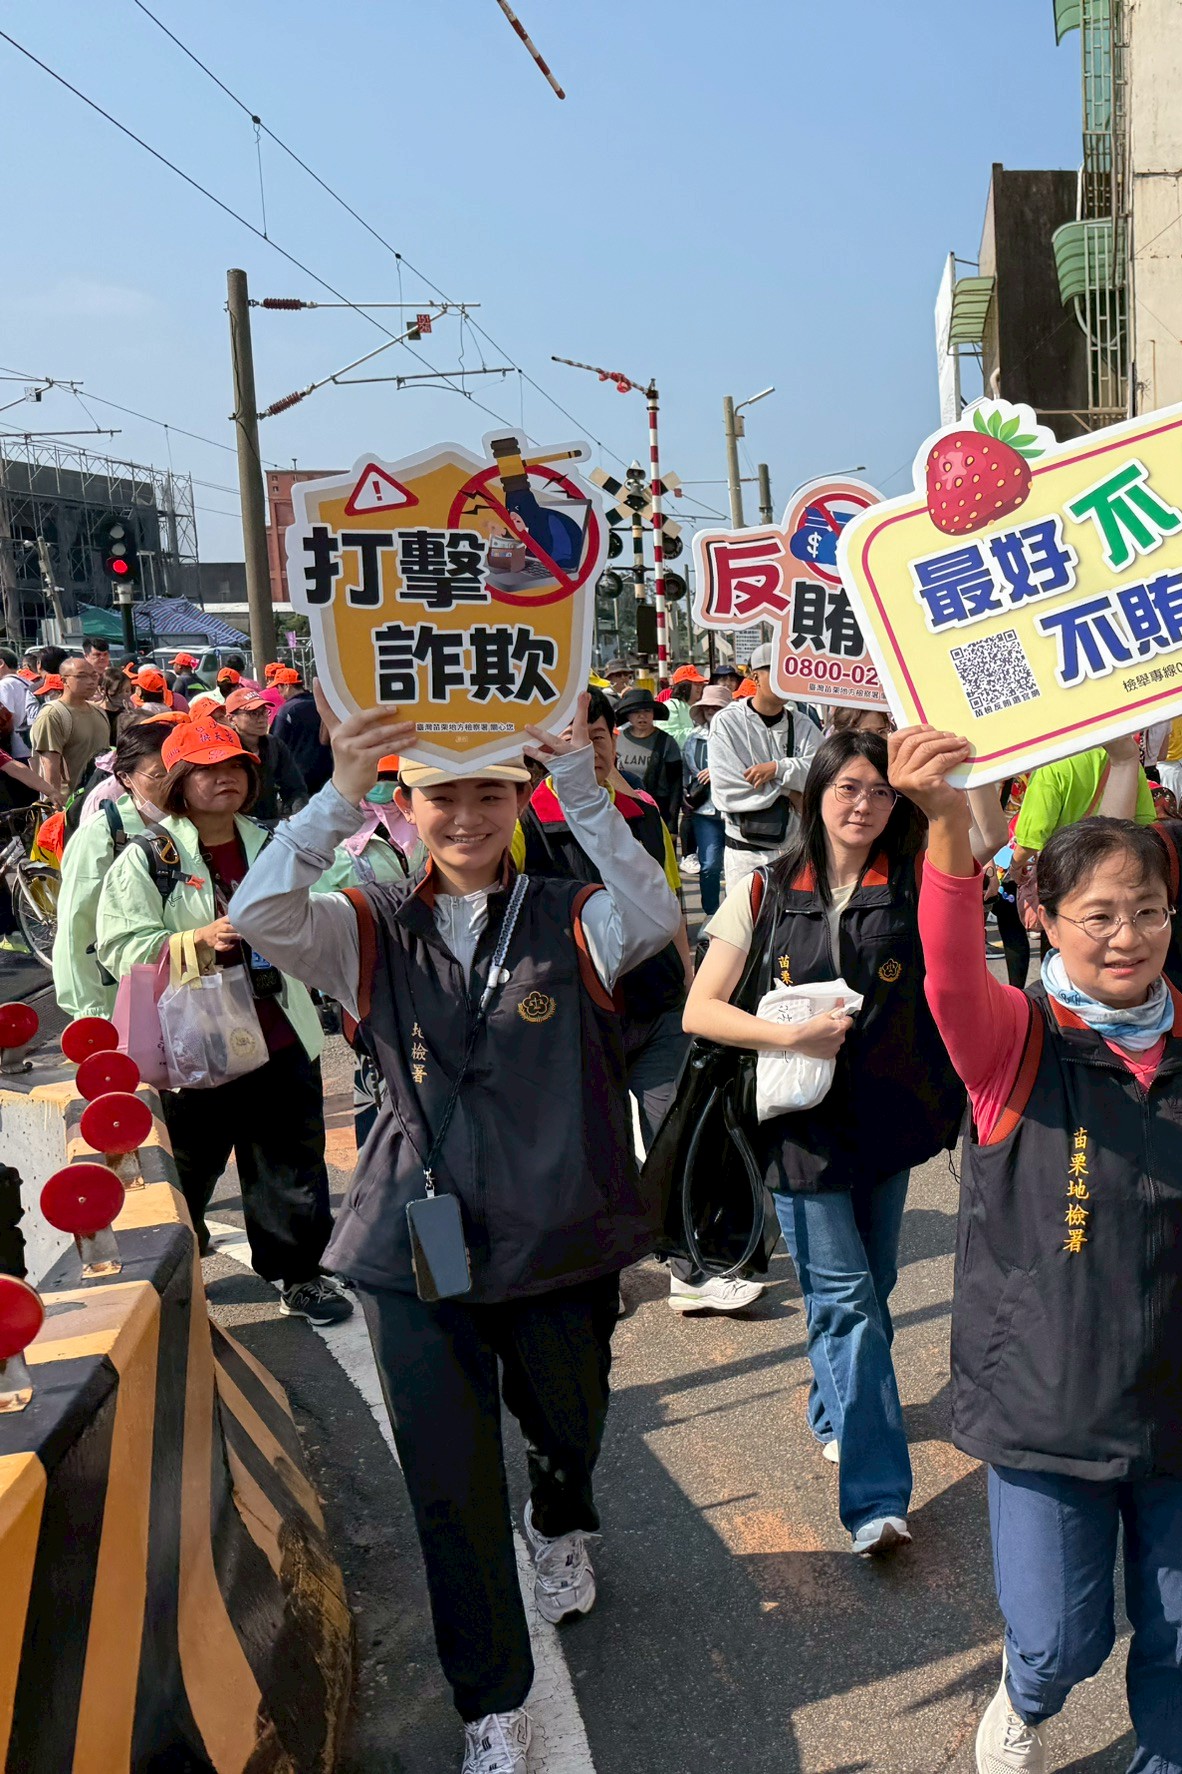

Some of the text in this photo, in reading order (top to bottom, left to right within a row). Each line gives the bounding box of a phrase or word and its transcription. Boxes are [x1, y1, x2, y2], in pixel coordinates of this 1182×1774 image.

[303, 527, 488, 608] 打擊
[915, 520, 1071, 627] 最好
[1071, 465, 1181, 566] 不
[375, 625, 556, 700] 詐欺
[778, 955, 793, 985] 苗栗
[1063, 1128, 1090, 1253] 苗栗地檢署
